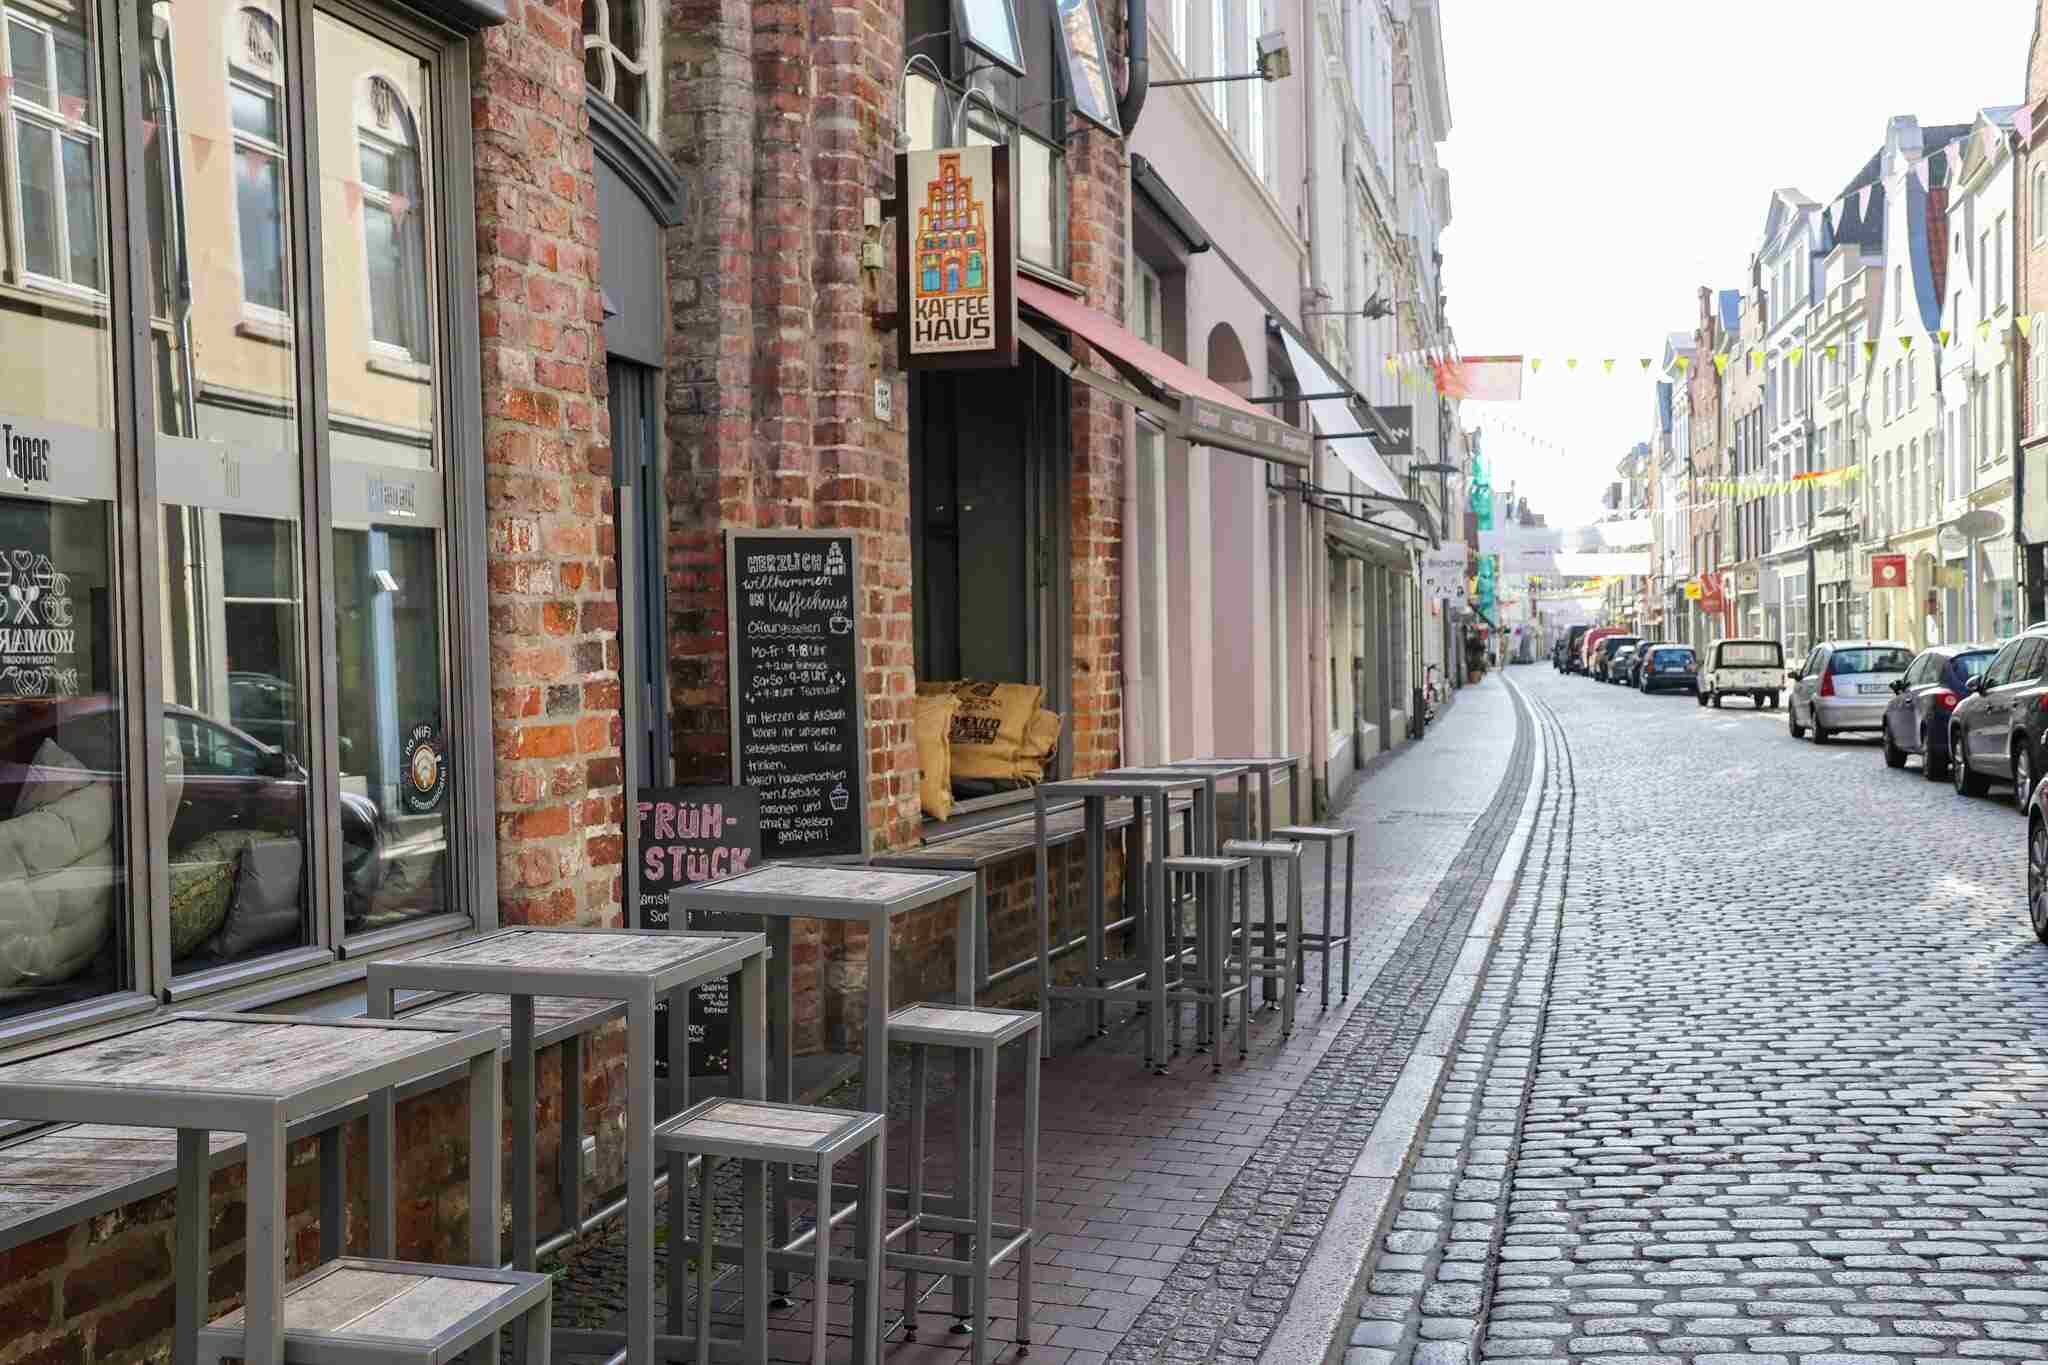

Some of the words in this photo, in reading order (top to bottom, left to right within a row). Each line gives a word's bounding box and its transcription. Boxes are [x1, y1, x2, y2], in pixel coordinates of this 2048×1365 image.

[915, 296, 990, 320] KAFFEE
[915, 317, 990, 341] HAUS
[2, 423, 50, 491] Tapas
[746, 552, 822, 573] HERZLICH
[742, 575, 833, 590] willkommen
